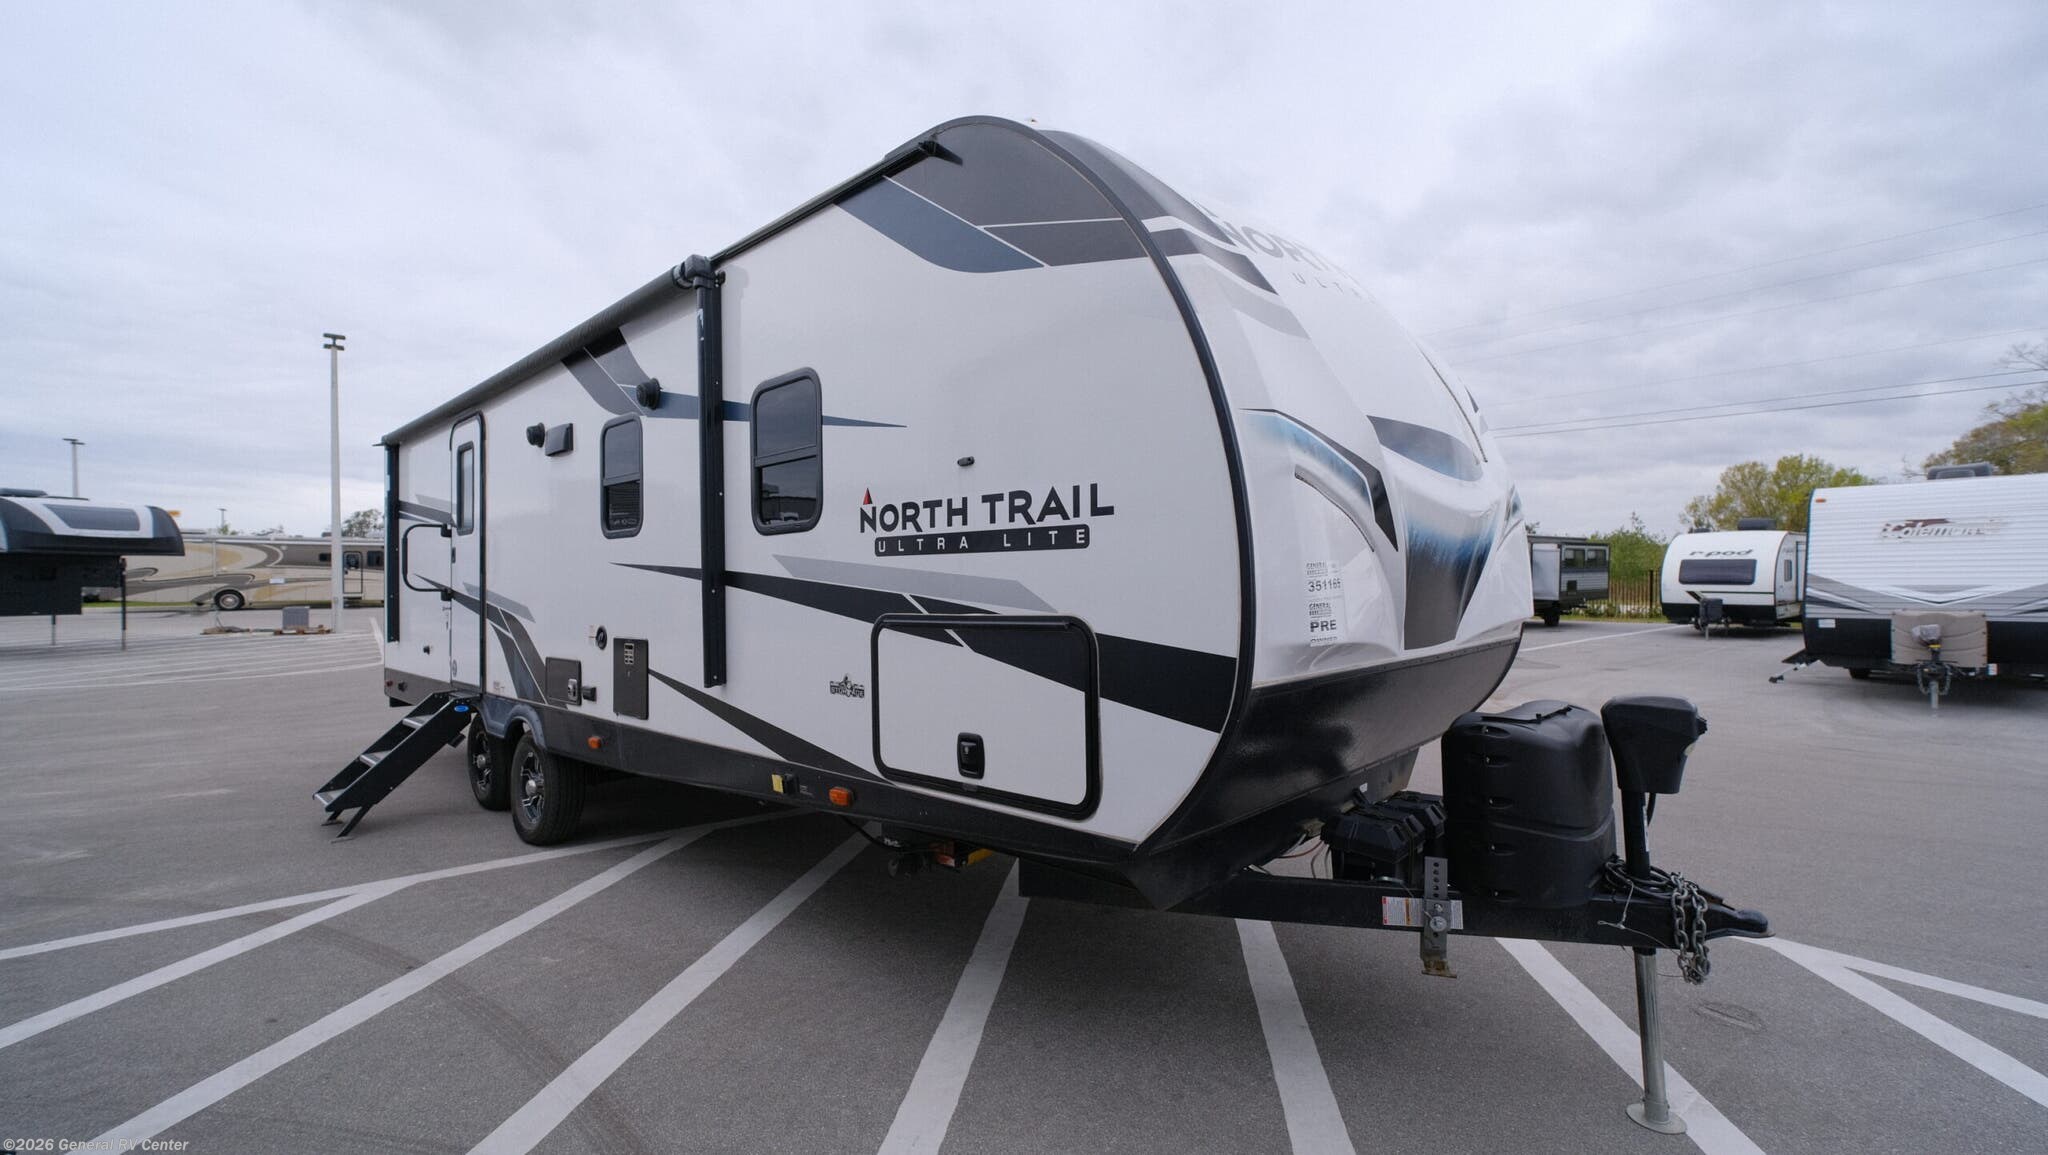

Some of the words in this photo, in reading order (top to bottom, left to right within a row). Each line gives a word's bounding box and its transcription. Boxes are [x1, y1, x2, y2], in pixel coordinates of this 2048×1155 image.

[860, 496, 968, 533] NORTH
[981, 483, 1114, 525] TRAIL
[878, 536, 968, 552] ULTRA
[1003, 529, 1085, 547] LITE
[1310, 620, 1337, 632] PRE
